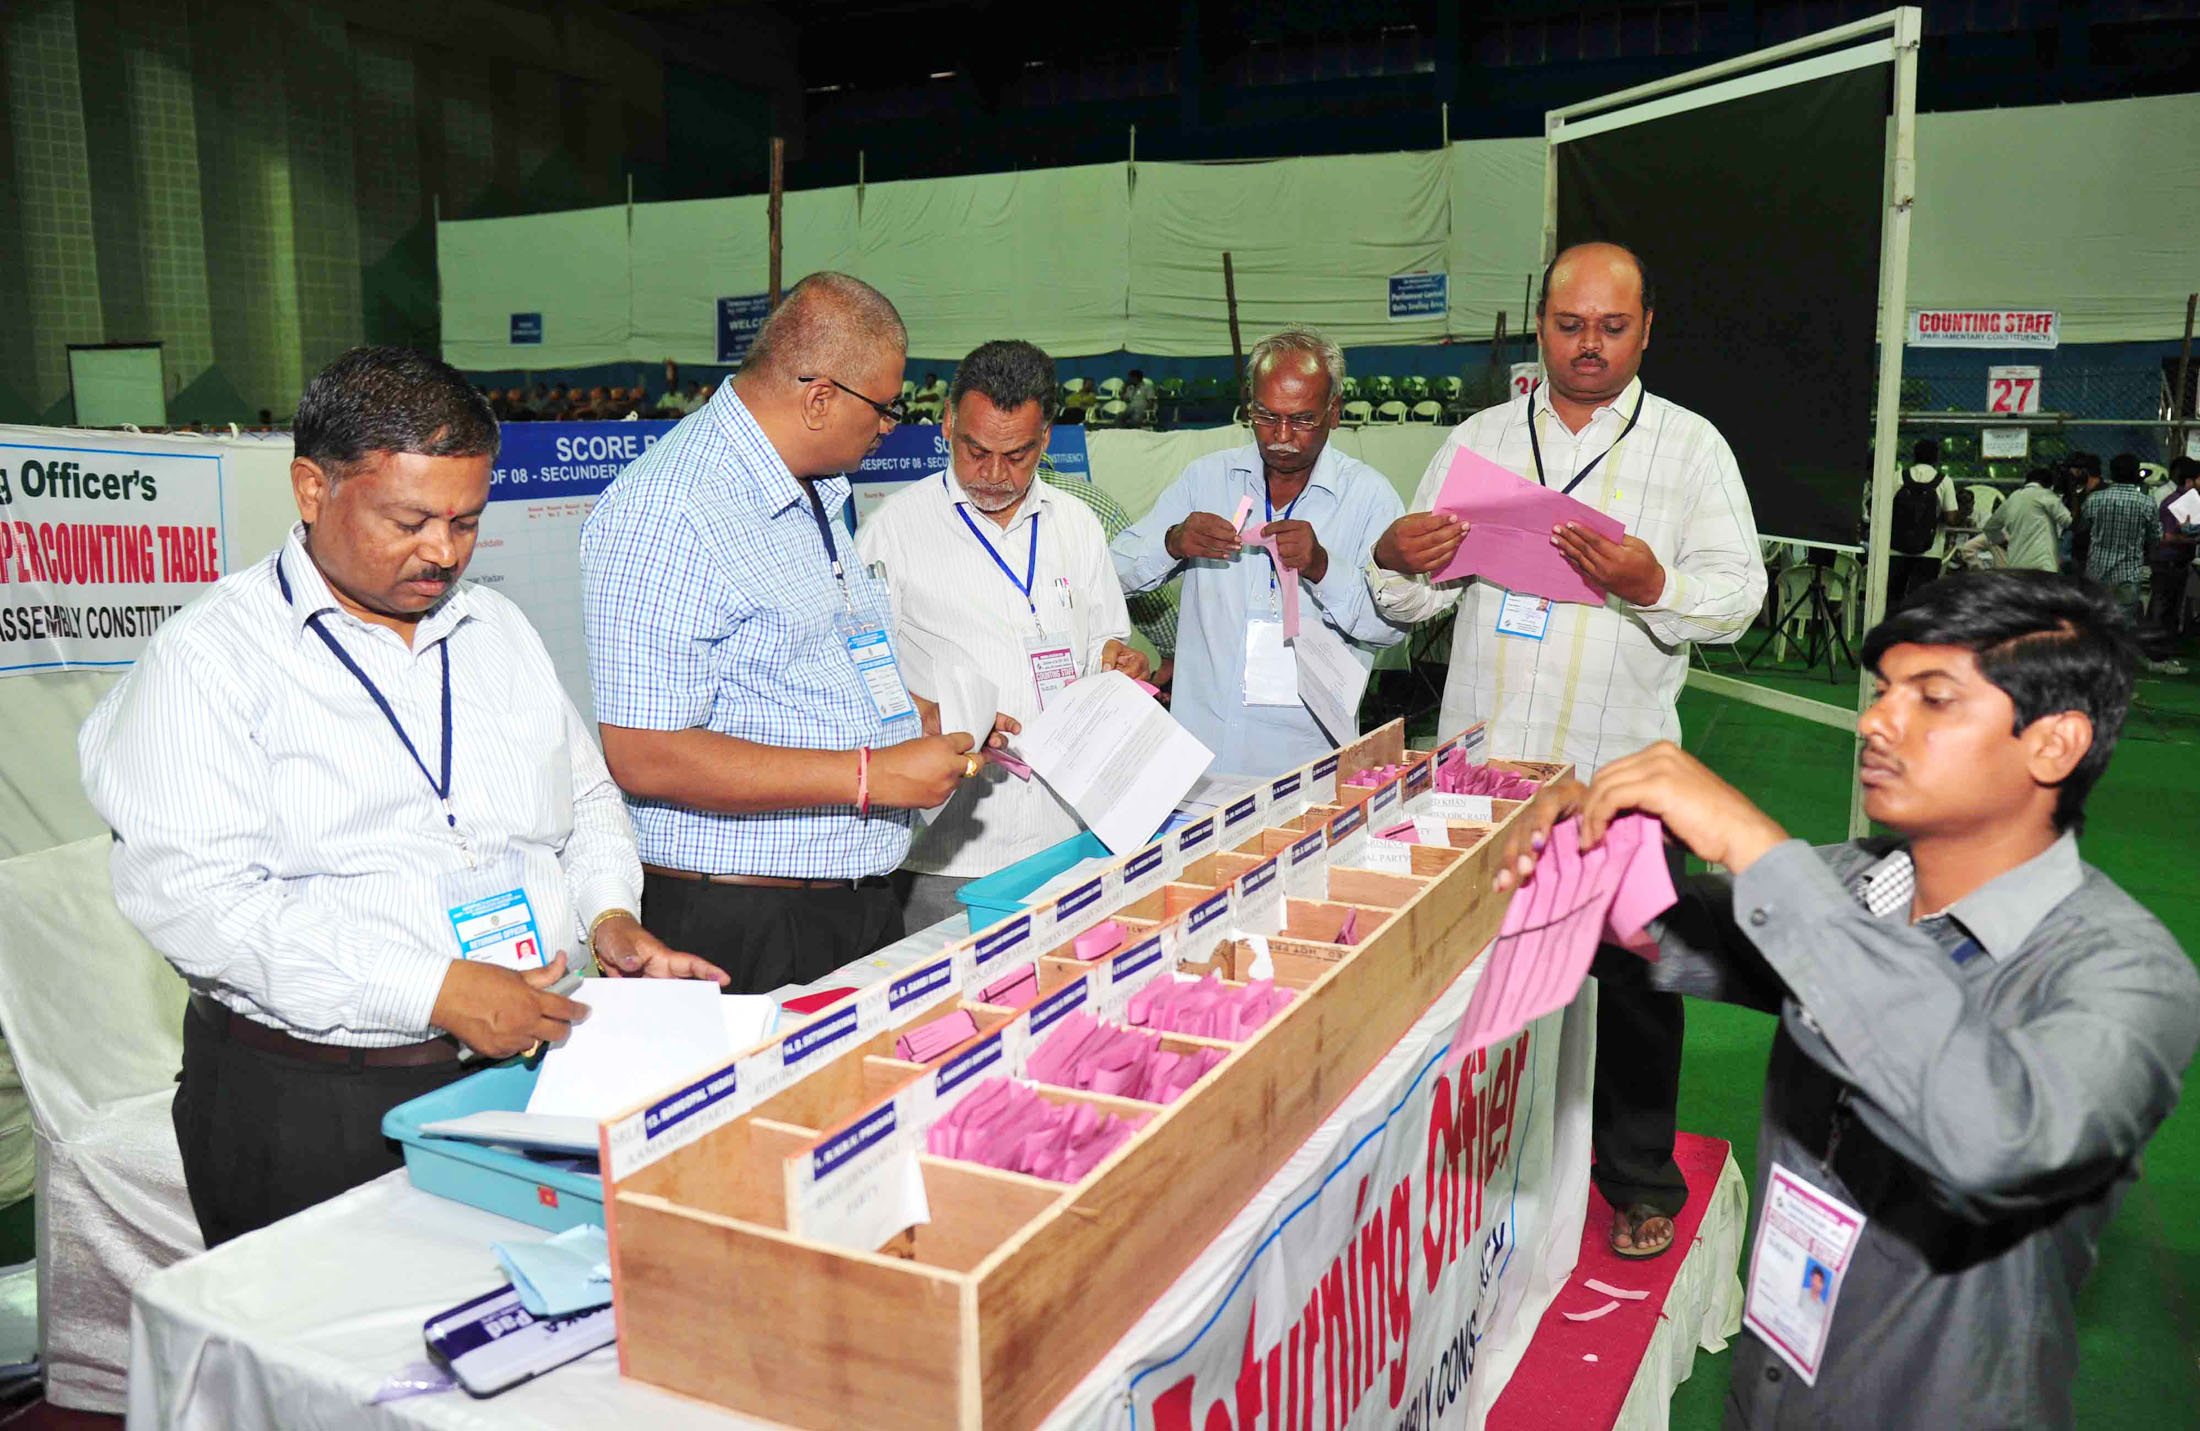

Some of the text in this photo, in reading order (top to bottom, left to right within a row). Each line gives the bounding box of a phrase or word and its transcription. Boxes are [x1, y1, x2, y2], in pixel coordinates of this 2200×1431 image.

[729, 318, 762, 331] WELC
[1919, 312, 2053, 333] COUNTING STAFF
[1992, 378, 2034, 413] 27
[556, 435, 639, 462] SCORE
[511, 468, 528, 484] 08
[860, 458, 898, 471] RESPECT
[900, 458, 911, 469] OF
[20, 460, 158, 502] Officer's
[157, 525, 219, 583] TABLE
[86, 605, 182, 639] CONSTIT
[1152, 1175, 1411, 1431] turning
